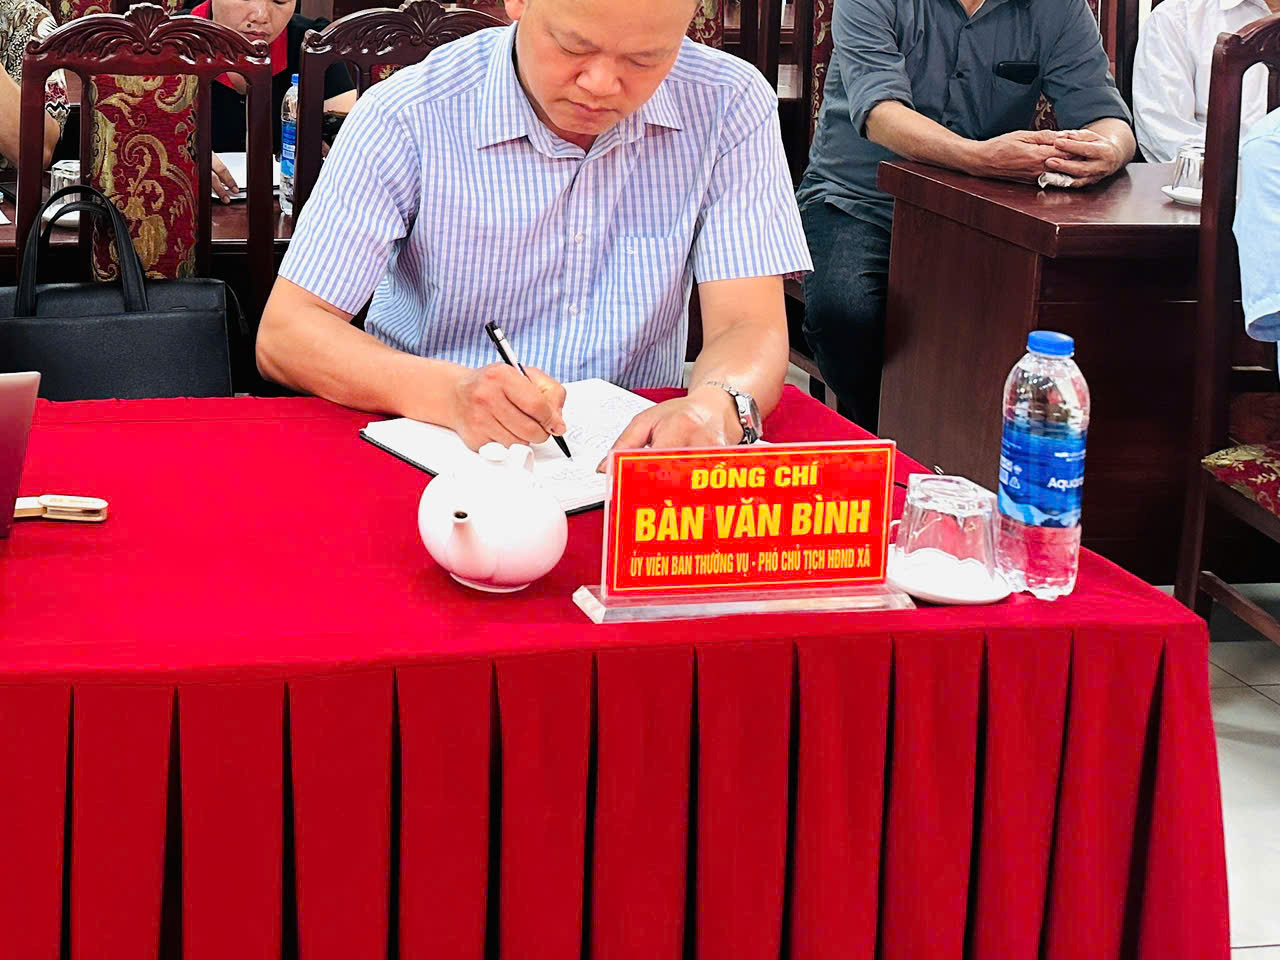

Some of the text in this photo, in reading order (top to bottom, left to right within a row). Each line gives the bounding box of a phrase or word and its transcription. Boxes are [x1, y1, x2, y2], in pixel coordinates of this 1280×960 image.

[690, 460, 819, 490] ĐỒNG CHÍ
[635, 494, 871, 542] BÀN VĂN BÌNH
[646, 551, 669, 577] VIÊN
[671, 554, 693, 576] BAN
[736, 551, 749, 577] VỤ
[758, 546, 779, 572] PHÓ
[781, 543, 801, 572] CHỦ
[803, 549, 825, 575] TỊCH
